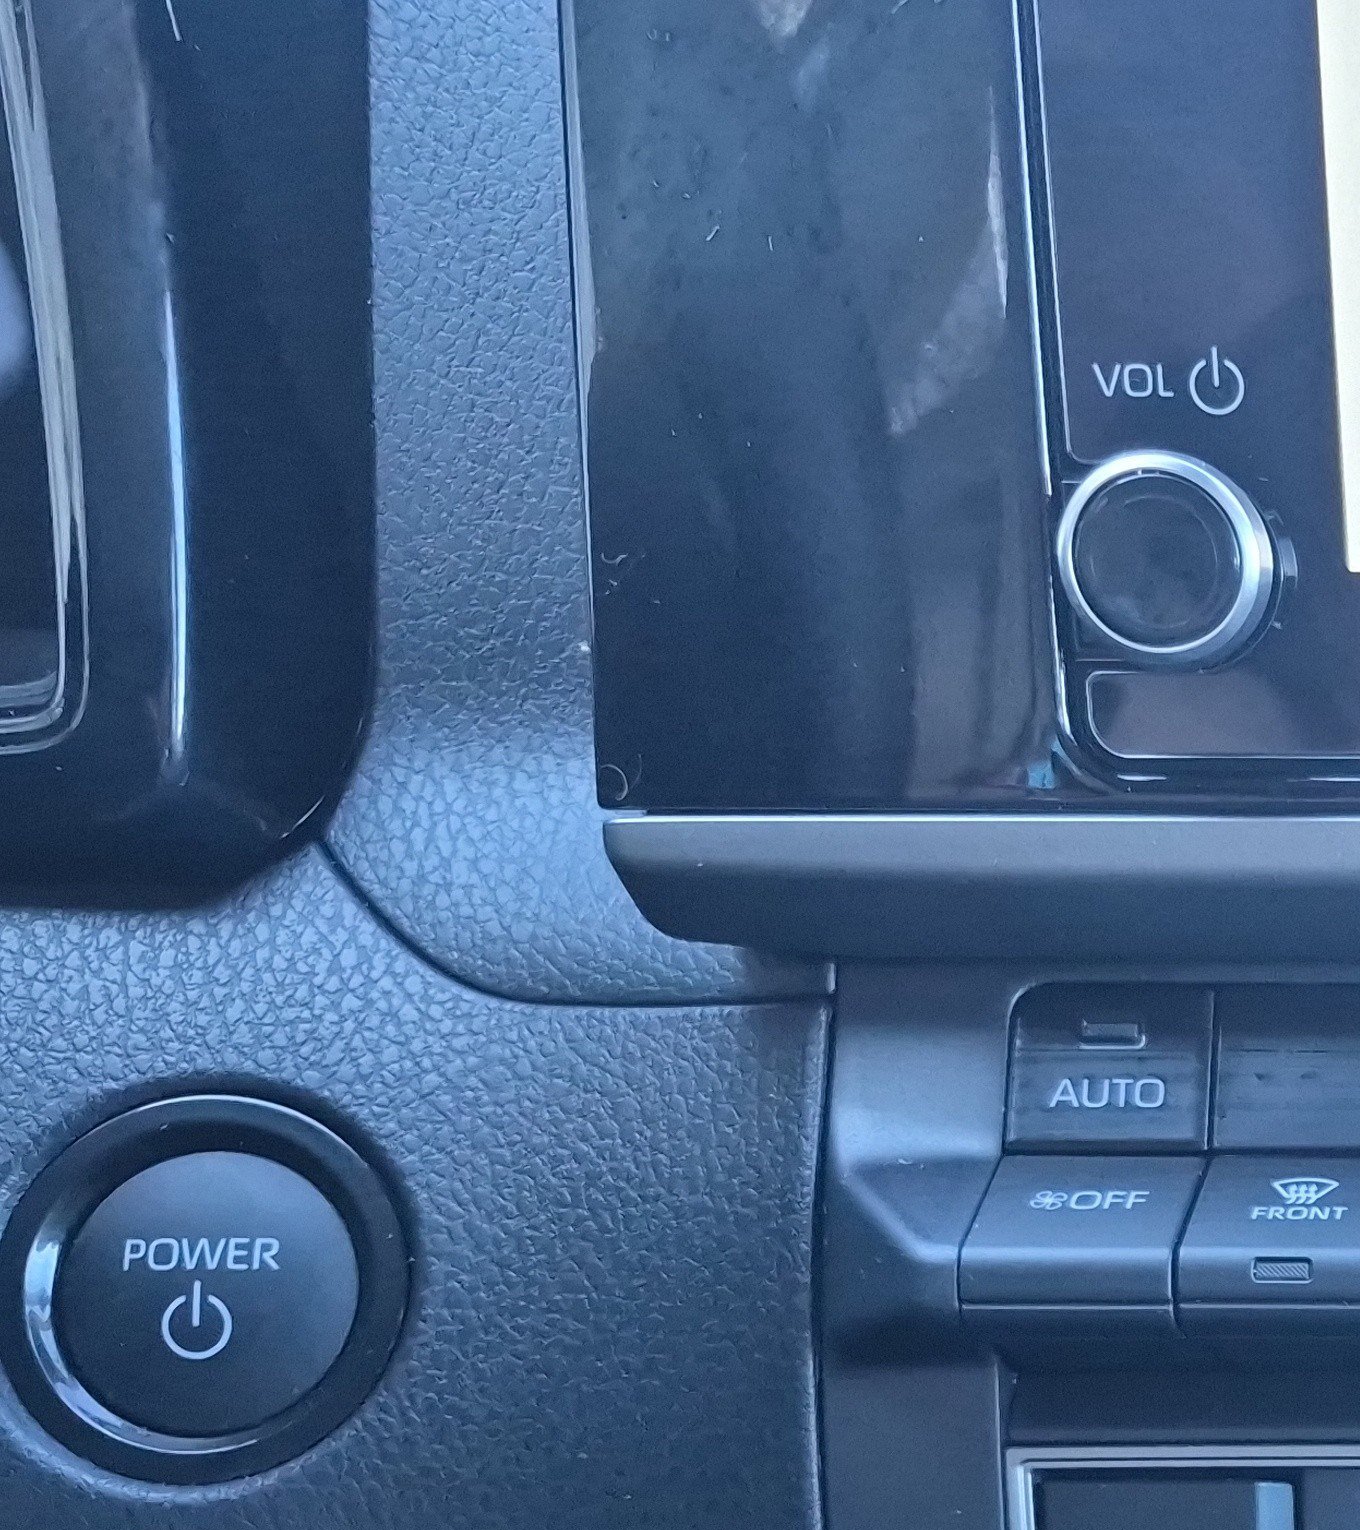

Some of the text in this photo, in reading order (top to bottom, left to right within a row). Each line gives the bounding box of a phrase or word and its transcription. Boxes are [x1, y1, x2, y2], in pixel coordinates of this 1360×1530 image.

[1092, 362, 1175, 398] VOL
[1049, 1077, 1167, 1109] AUTO
[1067, 1189, 1150, 1211] OFF
[1250, 1205, 1349, 1221] FRONT
[122, 1236, 281, 1273] POWER
